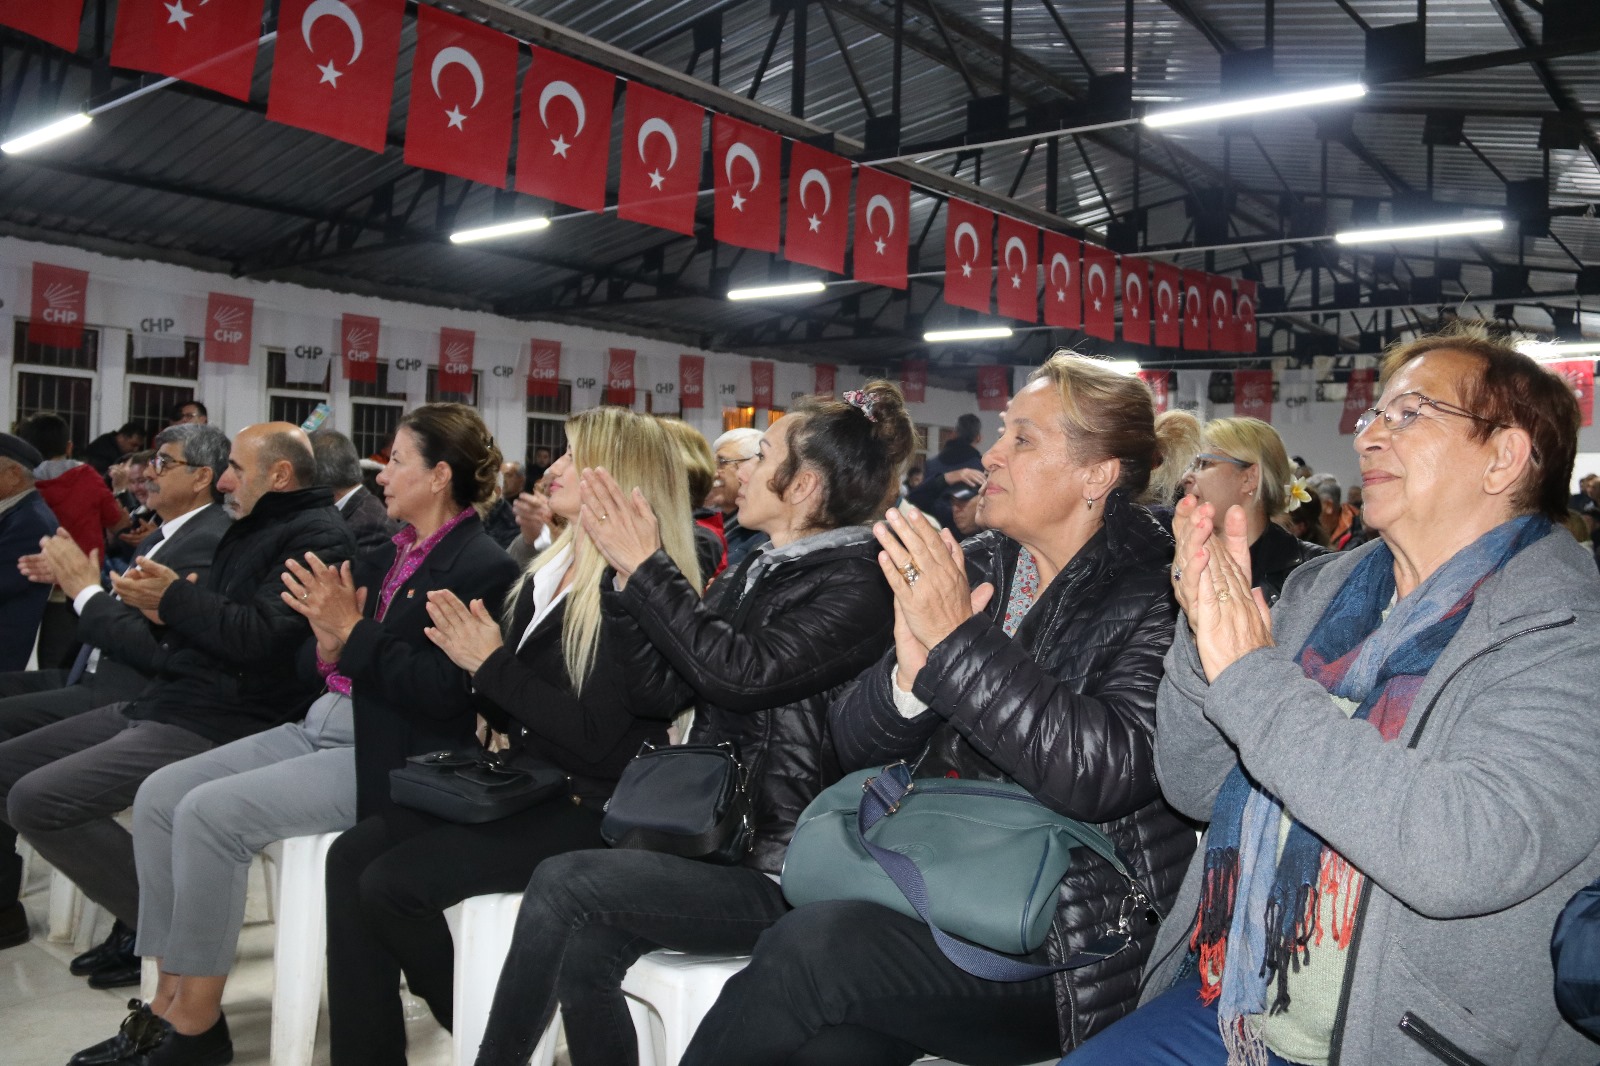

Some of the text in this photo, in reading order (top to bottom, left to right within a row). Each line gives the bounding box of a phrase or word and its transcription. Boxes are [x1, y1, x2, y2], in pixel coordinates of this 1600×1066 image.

[43, 308, 78, 324] CHP
[140, 318, 175, 333] CHP
[213, 330, 243, 344] CHP
[294, 345, 323, 360] CHP
[347, 350, 370, 362] CHP
[395, 358, 422, 371] CHP
[445, 363, 469, 375] CHP
[492, 365, 514, 378] CHP
[532, 368, 555, 379] CHP
[576, 377, 596, 389] CHP
[610, 379, 631, 389] CHP
[655, 383, 674, 394] CHP
